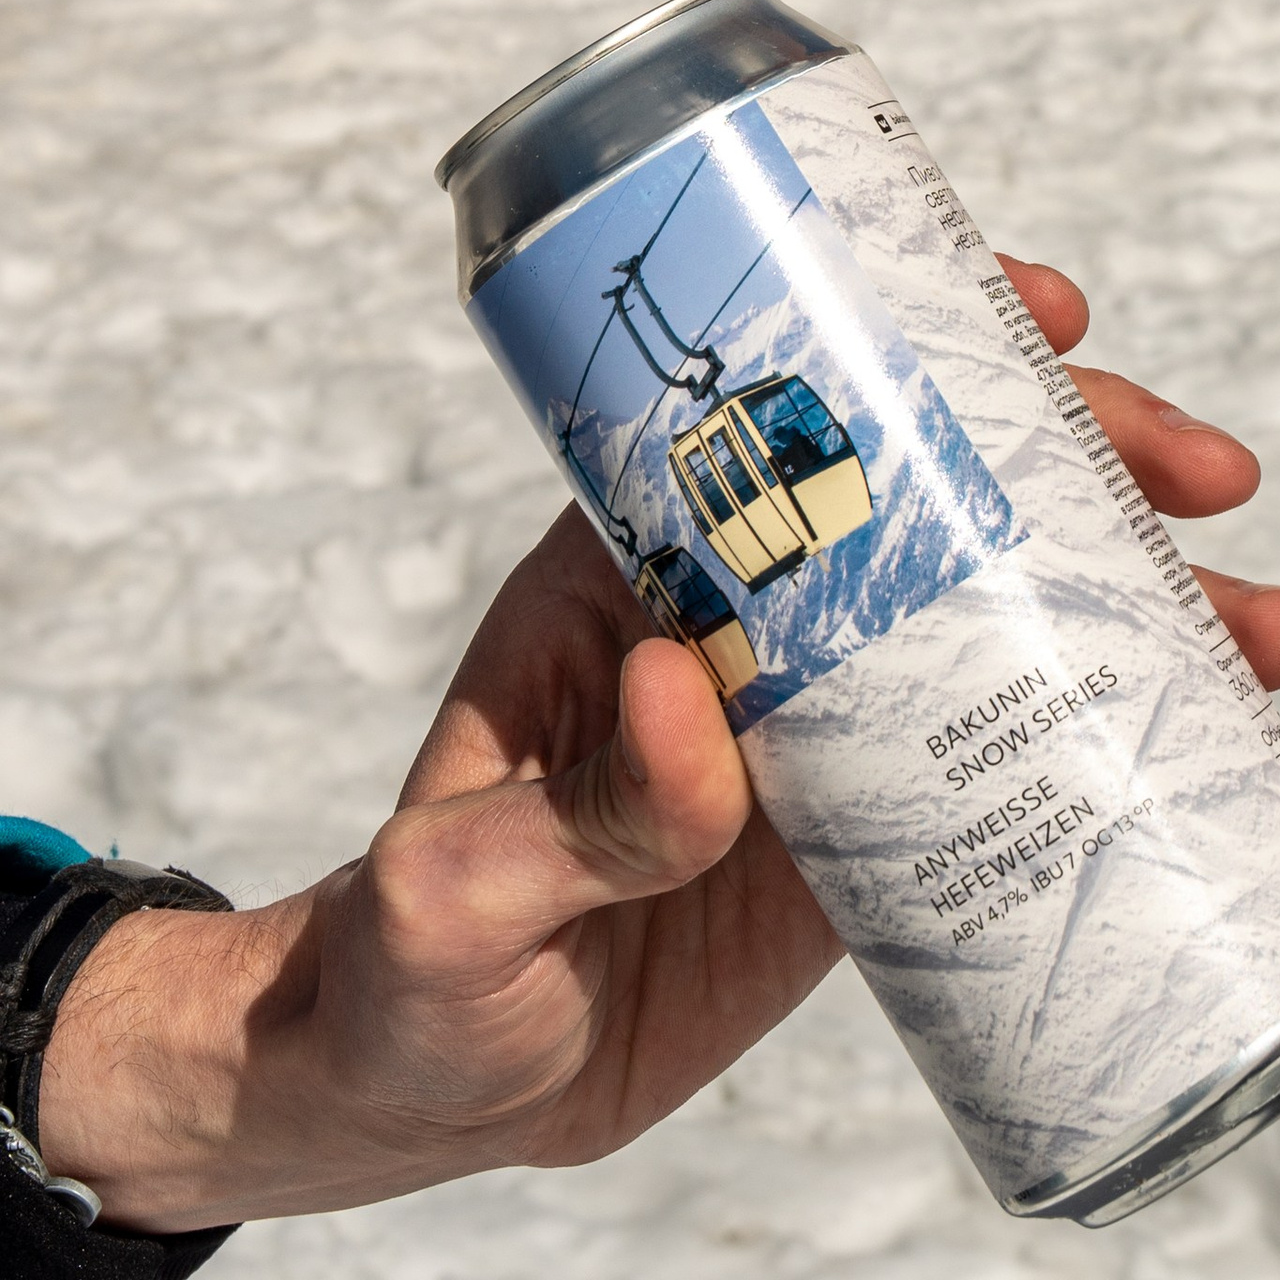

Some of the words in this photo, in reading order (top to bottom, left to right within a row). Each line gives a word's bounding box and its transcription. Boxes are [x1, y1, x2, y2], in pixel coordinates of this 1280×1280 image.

[907, 165, 941, 187] Пиво
[925, 667, 1048, 759] BAKUNIN
[946, 722, 1029, 791] SNOW
[1032, 664, 1118, 733] SERIES
[1228, 671, 1254, 701] 360
[913, 775, 1059, 887] ANYWEISSE
[930, 796, 1095, 918] HEFEWEIZEN
[952, 913, 984, 946] ABV
[988, 887, 1028, 920] 4,7%
[1030, 861, 1064, 892] IBU
[1063, 852, 1075, 869] 7
[1082, 828, 1114, 856] OG
